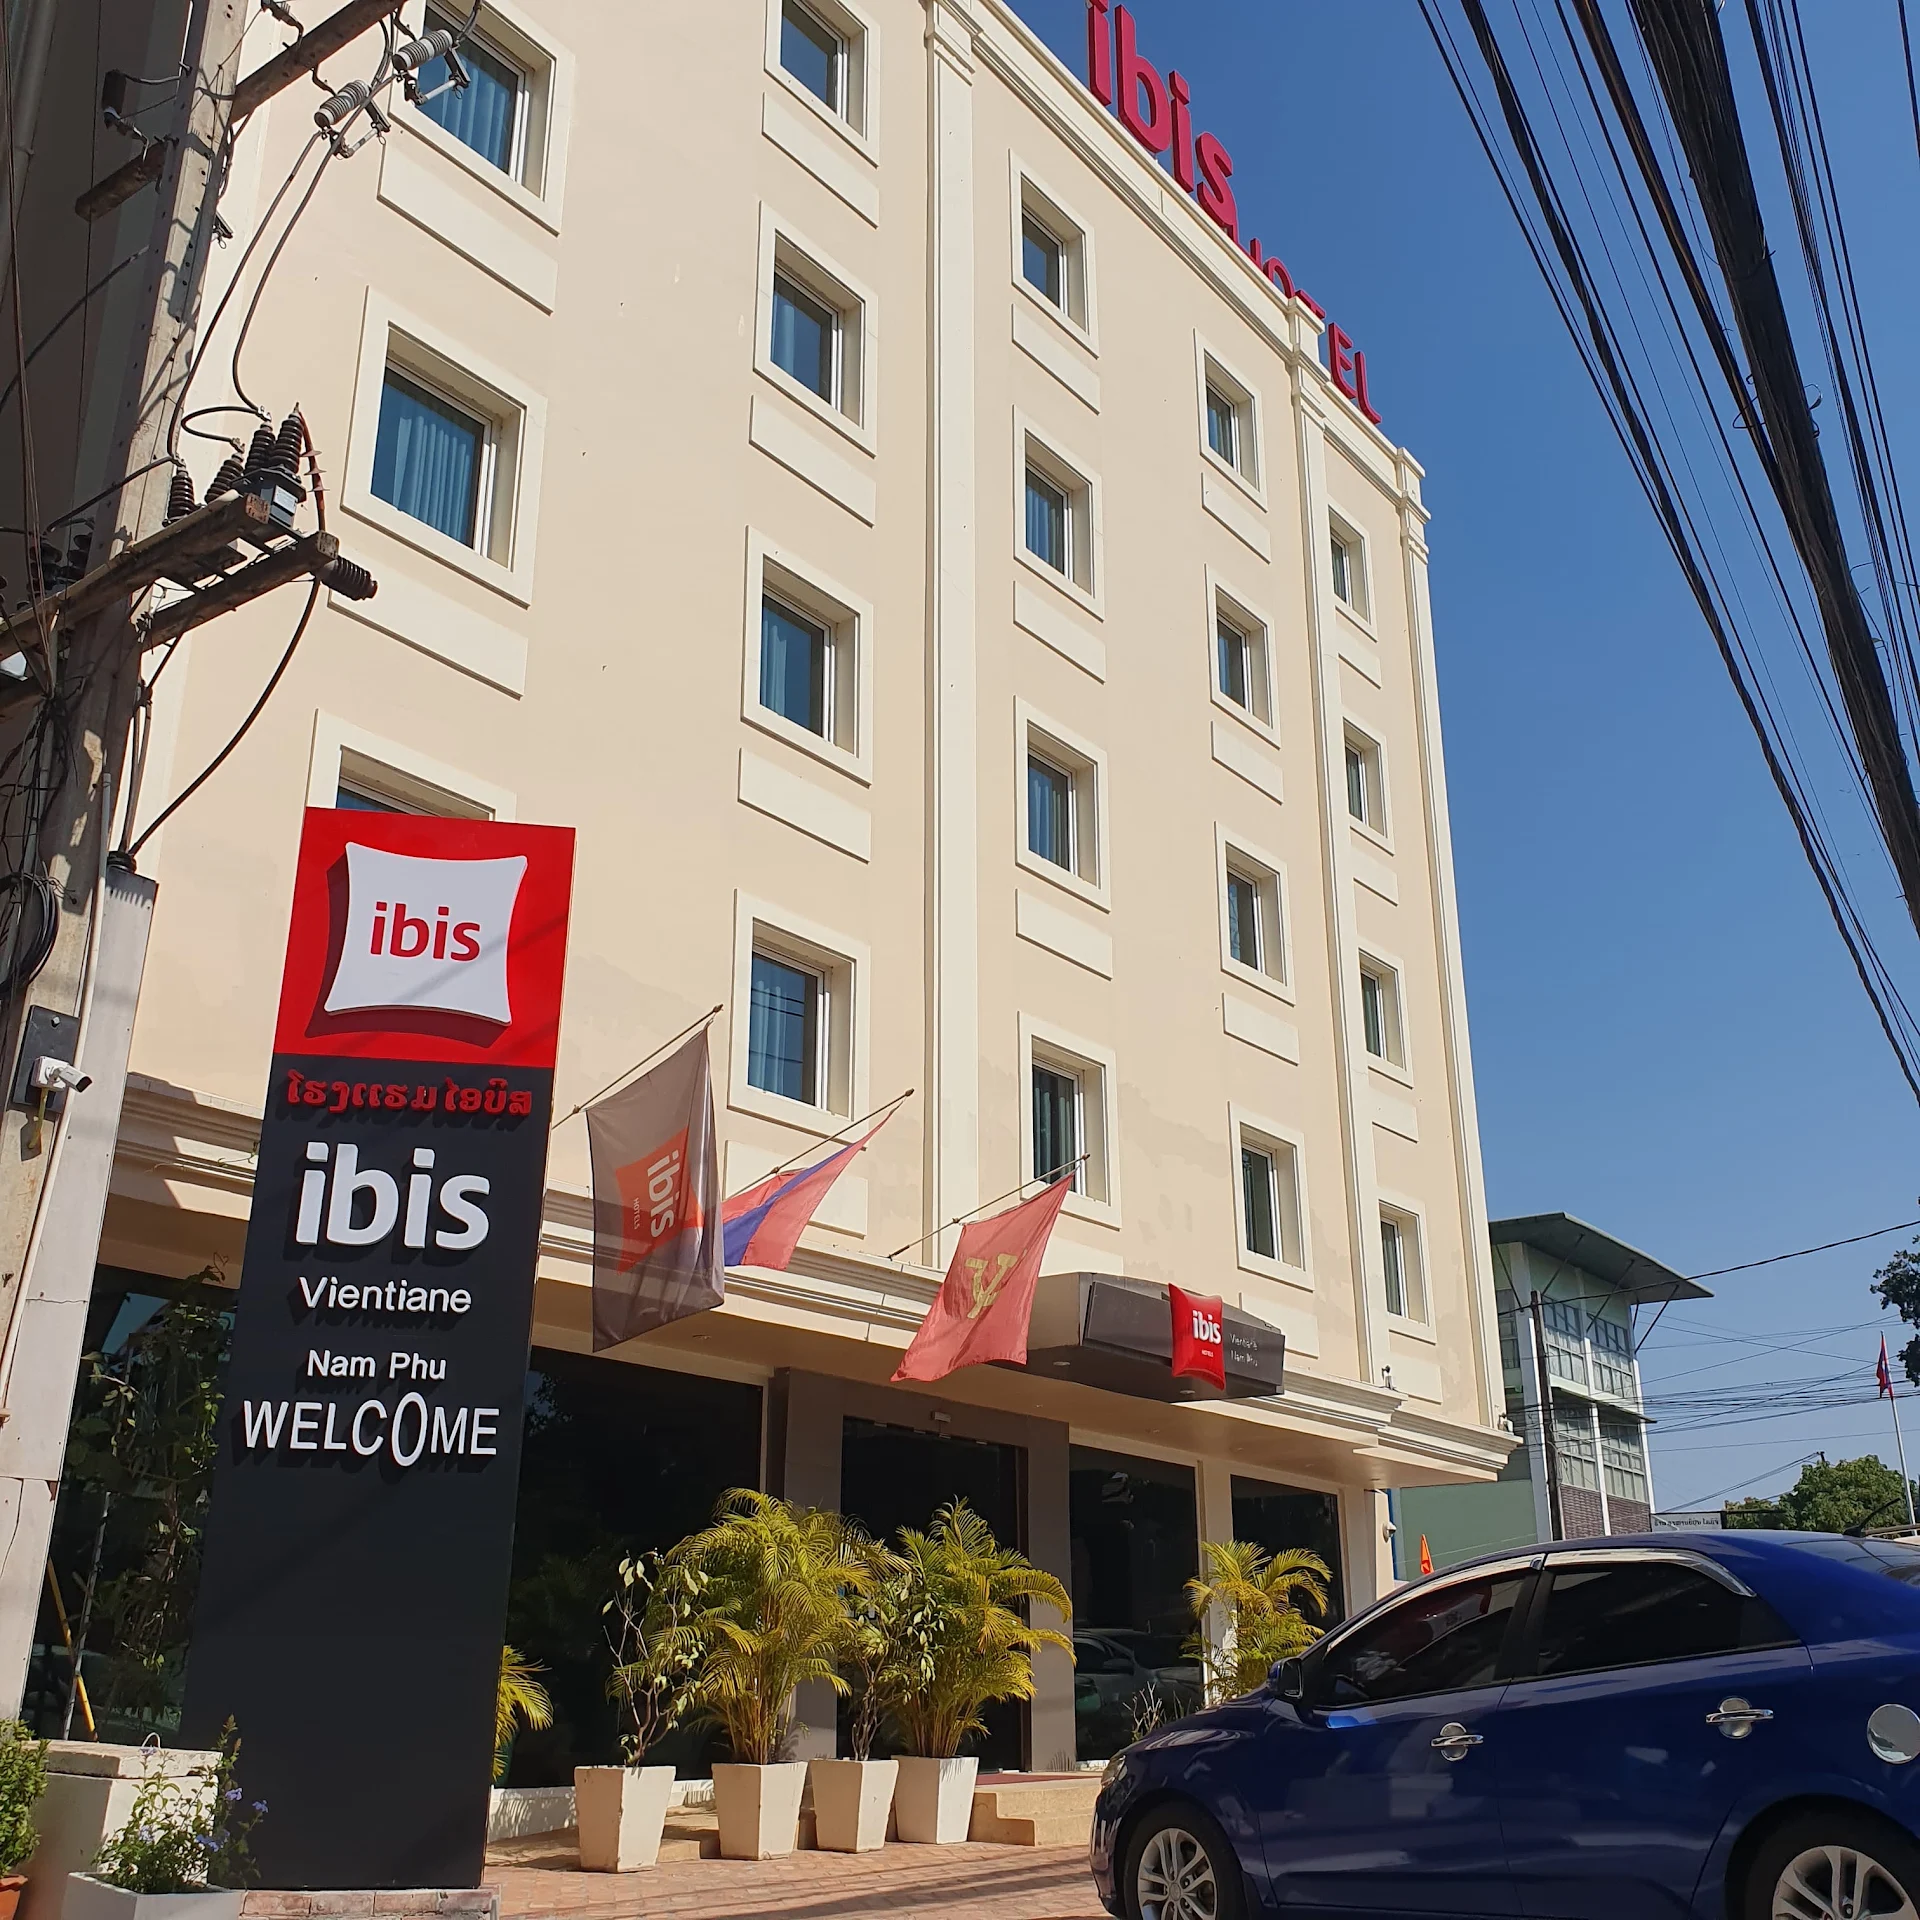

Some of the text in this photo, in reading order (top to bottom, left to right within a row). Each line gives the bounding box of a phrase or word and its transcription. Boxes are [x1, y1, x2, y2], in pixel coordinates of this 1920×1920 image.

[1087, 0, 1238, 228] ibis
[369, 900, 481, 962] ibis
[295, 1141, 491, 1250] ibis
[647, 1149, 681, 1238] ibis
[299, 1276, 472, 1314] Vientiane
[1192, 1310, 1221, 1344] ibis
[307, 1349, 447, 1380] Nam Phu
[243, 1391, 500, 1467] WELCOME
